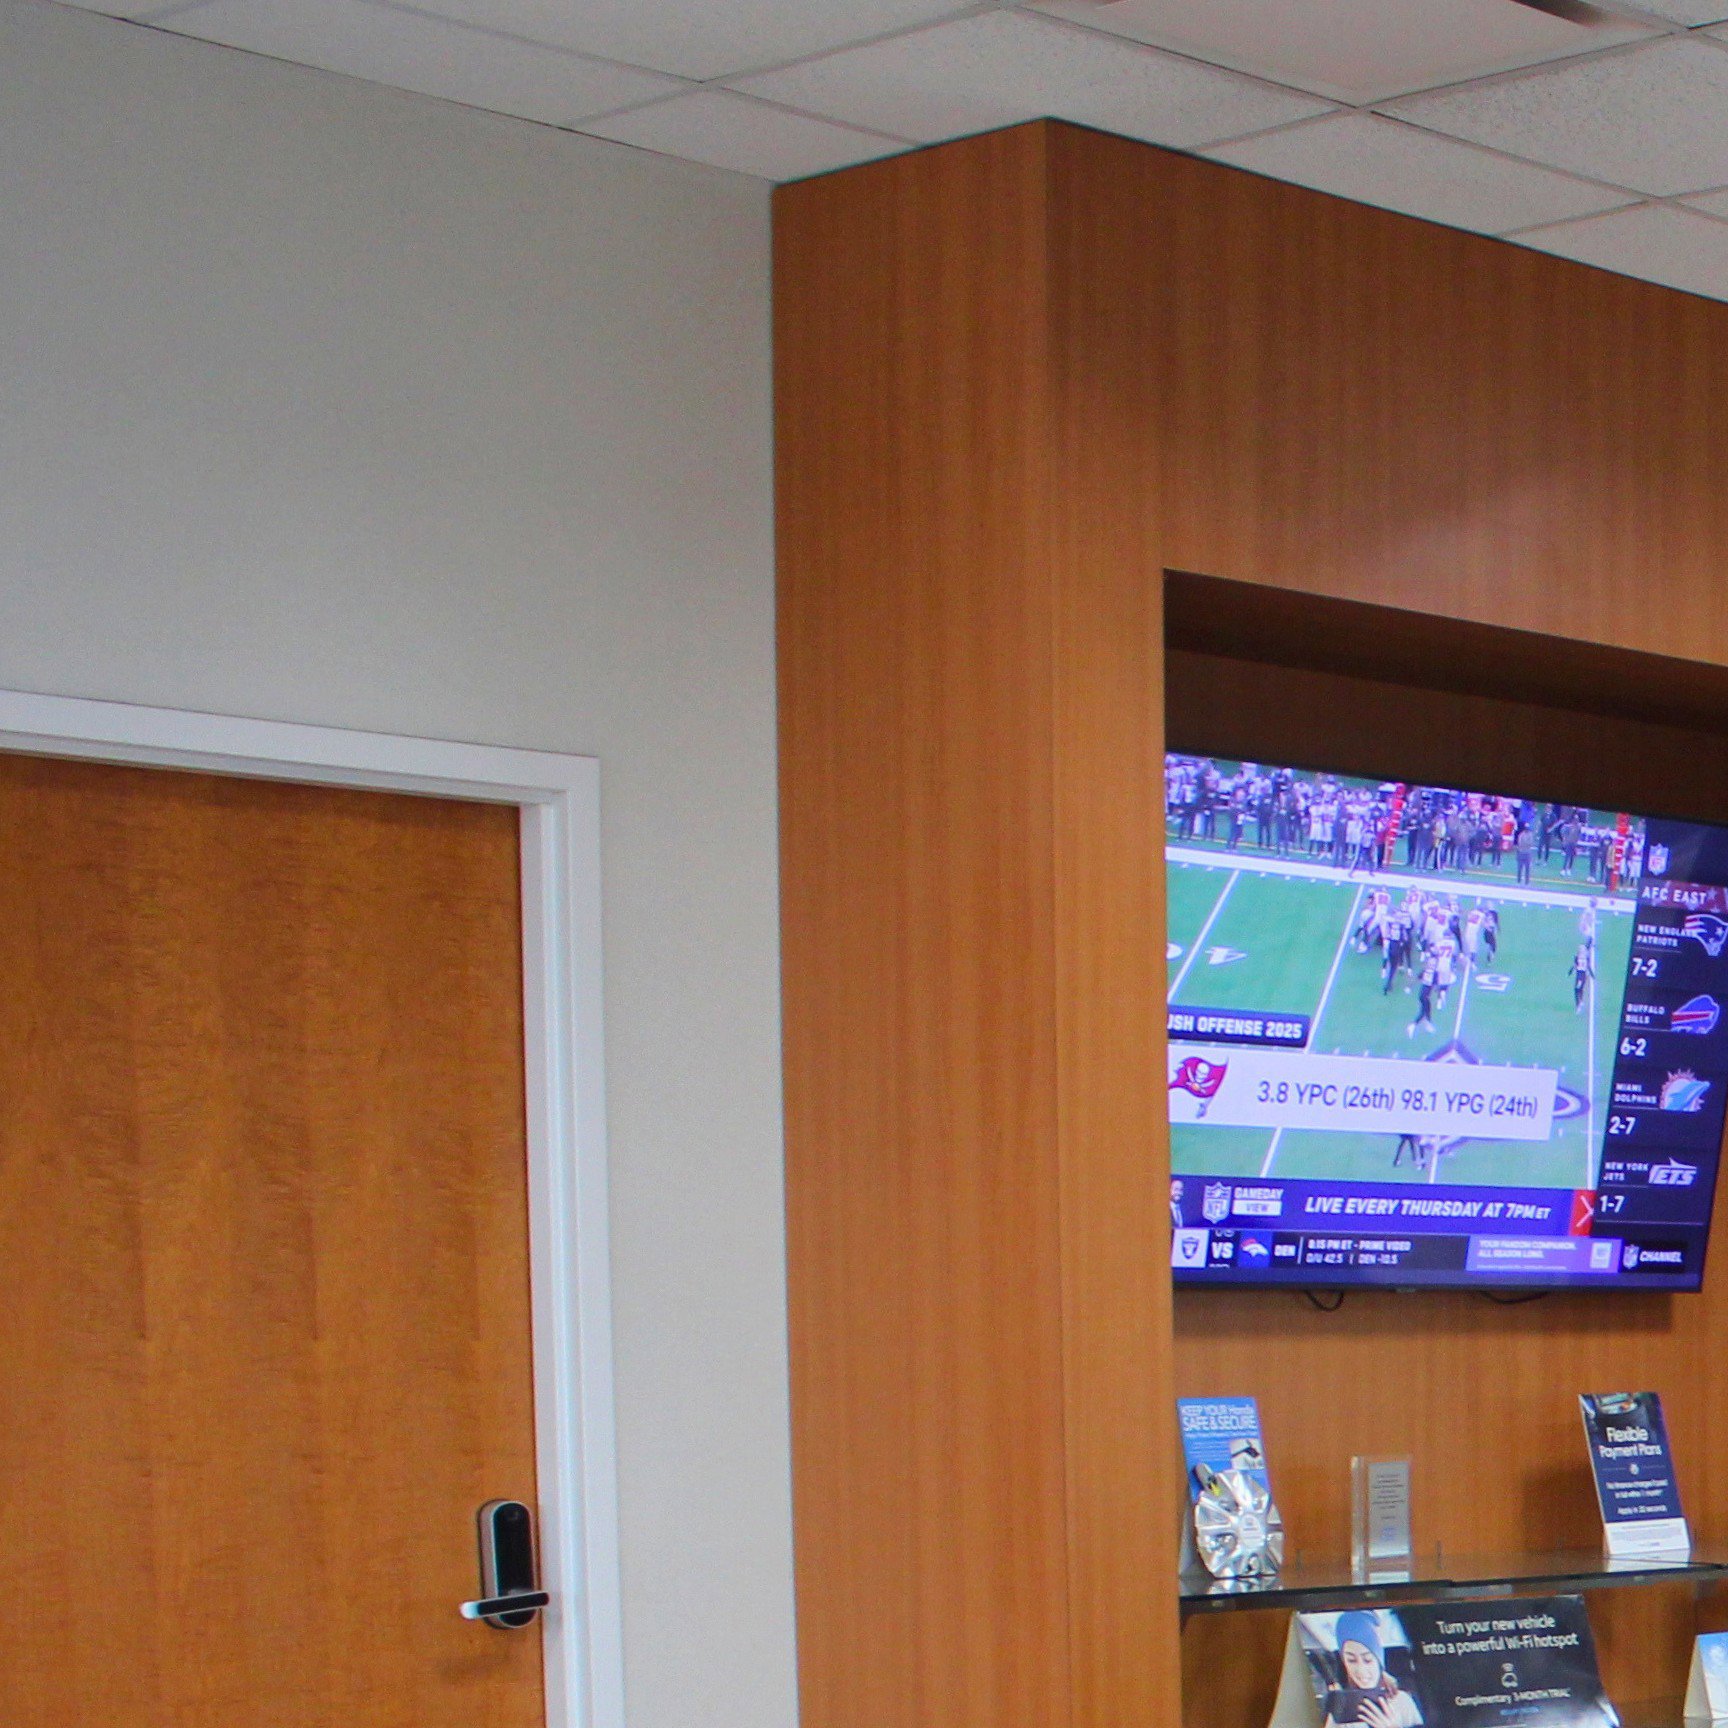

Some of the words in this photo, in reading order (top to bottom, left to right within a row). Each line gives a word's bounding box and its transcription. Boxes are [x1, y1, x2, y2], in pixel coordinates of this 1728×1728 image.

[1641, 886, 1669, 900] AFC
[1672, 889, 1707, 905] EAST
[1658, 926, 1699, 938] ENGLAN
[1636, 935, 1678, 947] PATRIOTS
[1632, 957, 1658, 978] 7-2
[1626, 1003, 1666, 1015] BUFFALO
[1196, 1016, 1264, 1037] OFFENSE
[1265, 1021, 1303, 1039] 2025
[1620, 1036, 1647, 1056] 6-2
[1615, 1083, 1643, 1093] MIAMI
[1256, 1080, 1290, 1104] 3.8
[1295, 1083, 1338, 1106] YPC
[1343, 1085, 1396, 1111] (26th)
[1400, 1088, 1438, 1112] 98.1
[1444, 1091, 1485, 1115] YPG
[1489, 1094, 1538, 1119] (24th)
[1614, 1093, 1658, 1105] DOLPHINS
[1609, 1115, 1636, 1134] 2-7
[1604, 1161, 1624, 1171] NEW
[1625, 1162, 1649, 1172] YORK
[1603, 1172, 1625, 1181] JETS
[1233, 1186, 1284, 1200] GAMEDAY
[1246, 1202, 1270, 1213] VIEW
[1305, 1196, 1344, 1214] LIVE
[1345, 1197, 1400, 1216] EVERY
[1399, 1199, 1483, 1218] THURSDAY
[1482, 1202, 1504, 1218] AT
[1600, 1195, 1625, 1213] 1-7
[1211, 1242, 1234, 1259] VS
[1274, 1244, 1297, 1258] DEN
[1359, 1240, 1385, 1251] PRIME
[1386, 1241, 1412, 1251] VIDEO
[1639, 1250, 1683, 1263] CHANNEL
[1183, 1416, 1209, 1432] SAFE
[1216, 1415, 1258, 1430] SECURE
[1605, 1425, 1650, 1443] Flexible
[1598, 1444, 1638, 1460] Payment
[1637, 1443, 1663, 1456] Plans
[1435, 1621, 1465, 1635] Turn
[1464, 1620, 1491, 1636] your
[1491, 1620, 1516, 1631] new
[1516, 1613, 1556, 1631] vehicle
[1421, 1640, 1446, 1656] into
[1445, 1643, 1456, 1654] a
[1456, 1635, 1505, 1656] powerful
[1504, 1633, 1534, 1650] Wi-Fi
[1533, 1632, 1580, 1649] hotspot
[1455, 1694, 1513, 1707] Complimentary
